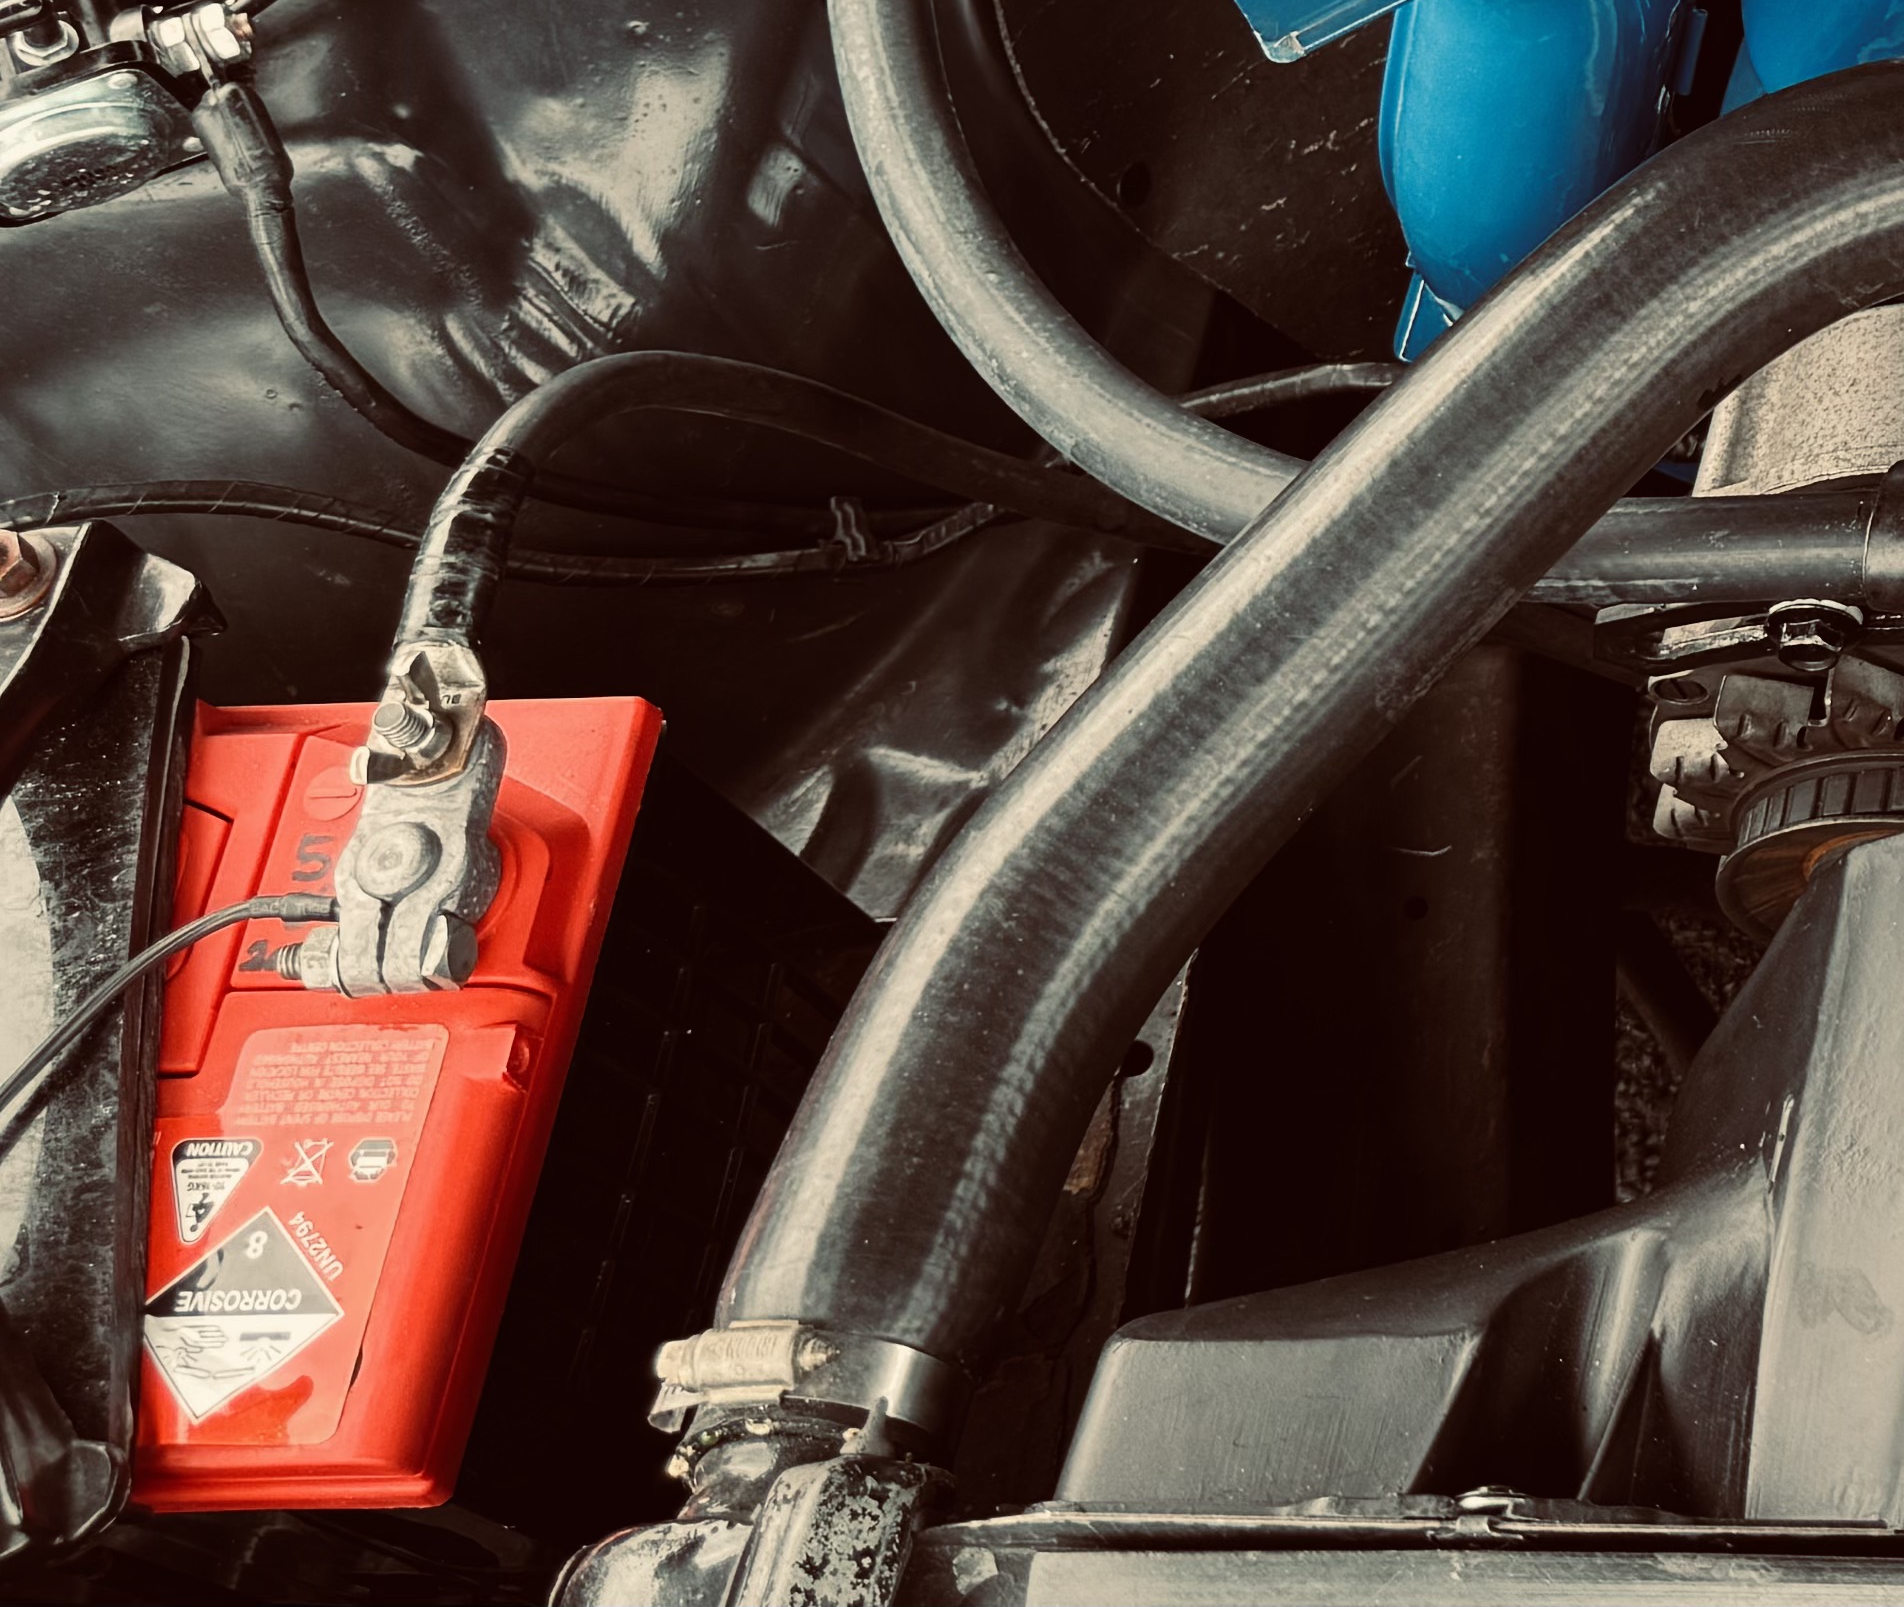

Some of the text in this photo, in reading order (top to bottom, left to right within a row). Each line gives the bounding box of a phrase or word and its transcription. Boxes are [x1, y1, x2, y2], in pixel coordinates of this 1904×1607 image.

[186, 1142, 254, 1158] CAUTION
[244, 1230, 269, 1260] 8
[288, 1211, 345, 1282] UN2794
[174, 1288, 302, 1313] CORROSIVE
